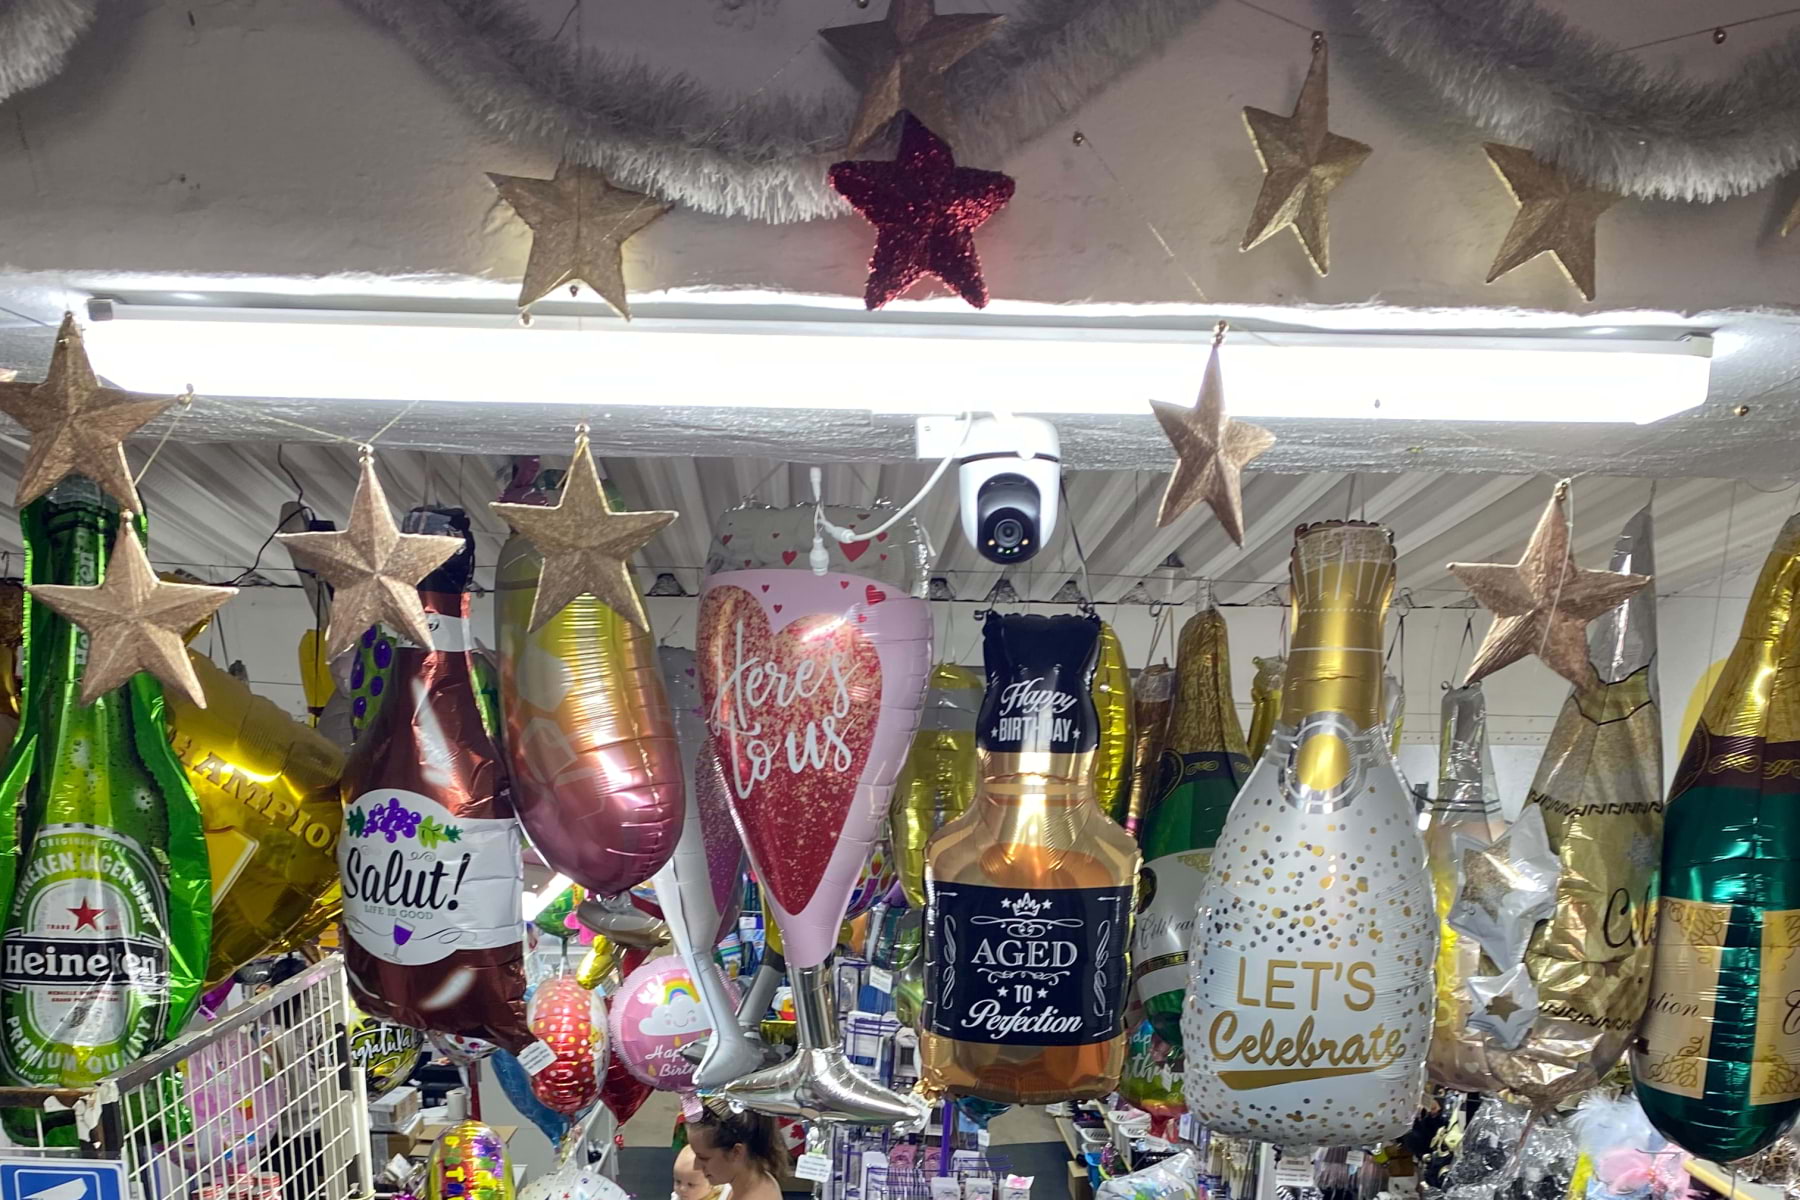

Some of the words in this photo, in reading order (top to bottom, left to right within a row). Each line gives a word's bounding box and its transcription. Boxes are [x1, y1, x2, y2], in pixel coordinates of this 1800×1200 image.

[1000, 677, 1079, 715] Happy
[785, 716, 860, 772] us
[998, 716, 1073, 742] BIRTHDAY
[12, 852, 76, 918] HEINEKEN
[80, 852, 134, 887] LAGER
[343, 846, 471, 911] Salut!
[364, 904, 384, 915] LIFE
[387, 905, 397, 917] IS
[400, 908, 434, 920] GOOD
[5, 944, 157, 977] Heineken
[971, 938, 1078, 968] AGED
[1014, 984, 1033, 1003] TO
[1237, 956, 1376, 1012] LET'S
[961, 999, 1084, 1040] Perfection
[1209, 1010, 1407, 1068] Celebrate
[7, 1016, 77, 1073] PREMIUM
